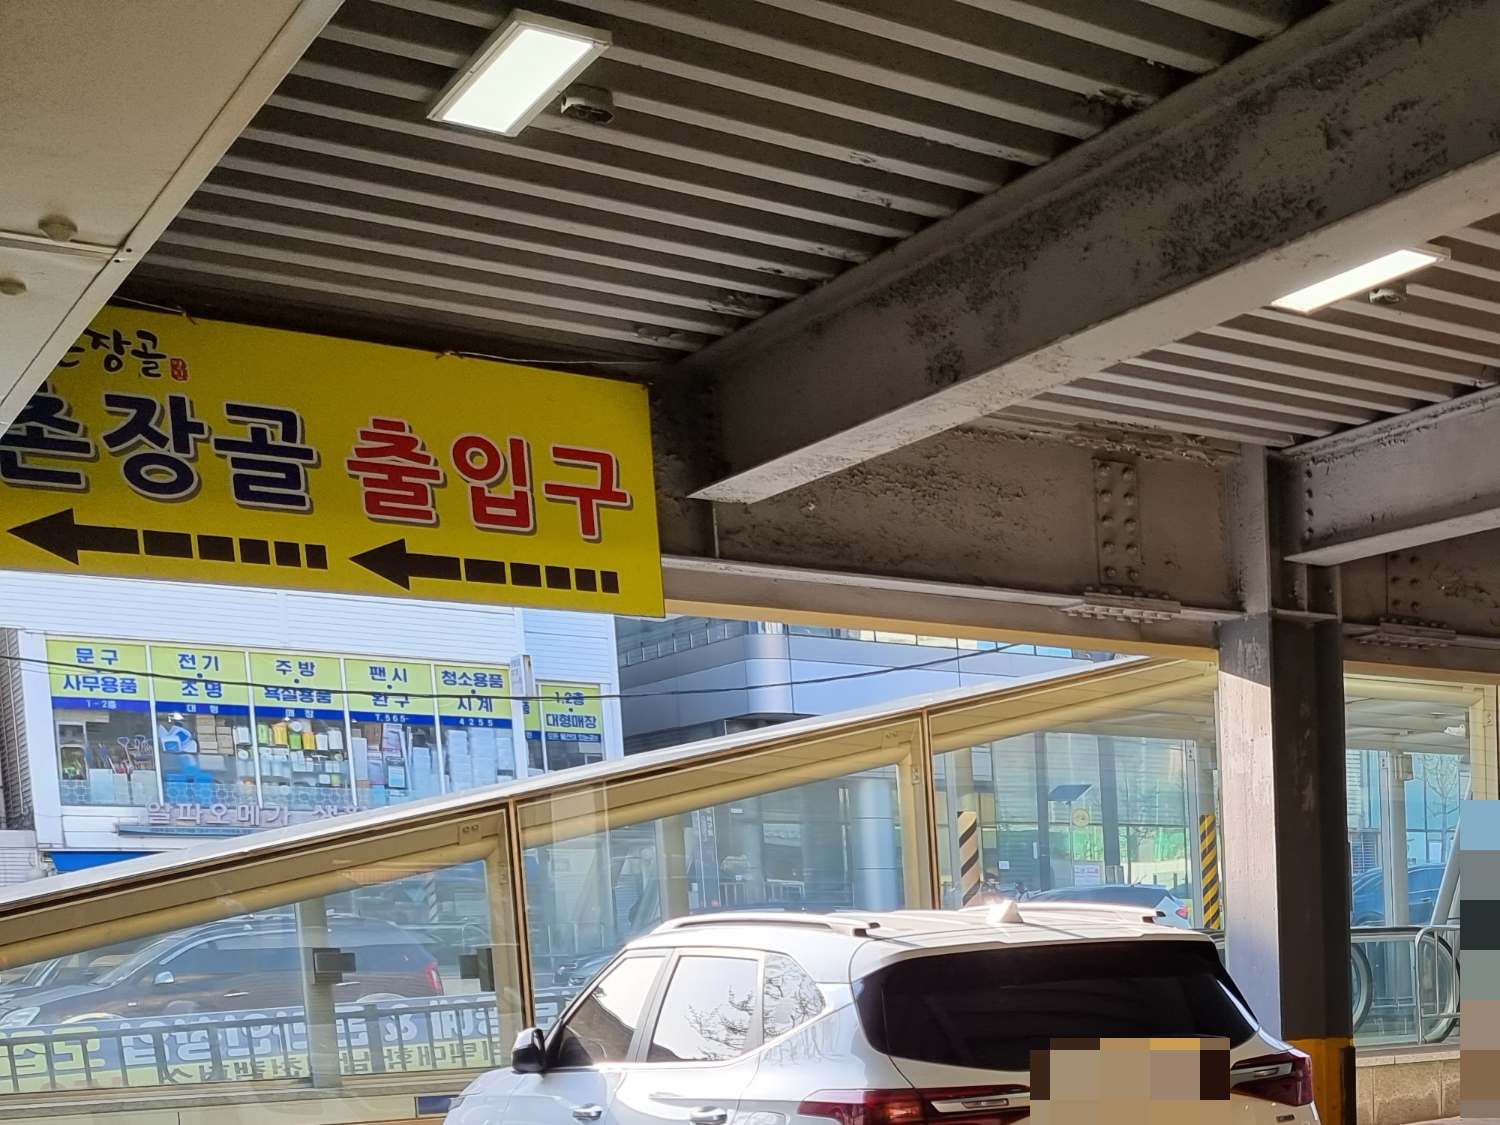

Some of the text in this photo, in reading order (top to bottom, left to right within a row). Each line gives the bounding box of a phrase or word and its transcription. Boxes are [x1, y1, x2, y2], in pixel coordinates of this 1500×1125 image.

[345, 417, 632, 541] 출입구
[63, 674, 137, 694] 사무용품
[441, 670, 503, 688] 청소용품
[264, 686, 332, 704] 욕실용품
[546, 713, 597, 729] 대형매장
[146, 803, 291, 827] 알파오메가
